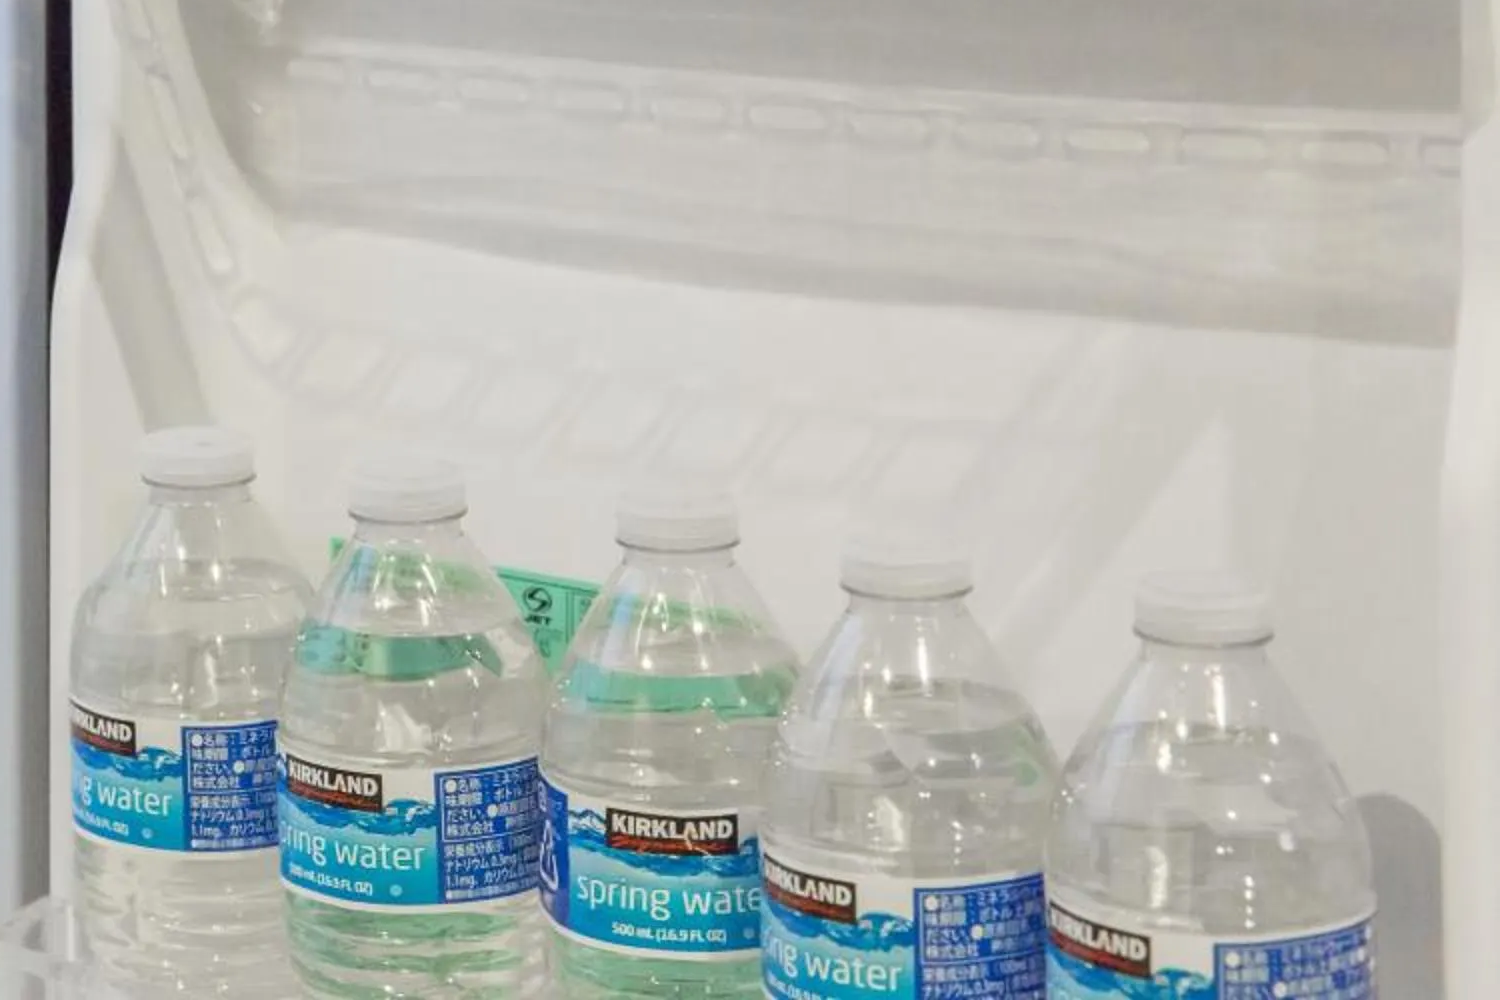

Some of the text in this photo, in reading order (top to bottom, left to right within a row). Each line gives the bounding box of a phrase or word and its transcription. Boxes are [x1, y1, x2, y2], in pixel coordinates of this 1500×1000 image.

[289, 759, 378, 797] KIRKLAND
[97, 781, 173, 817] water
[611, 813, 734, 840] KIRKLAND
[334, 840, 426, 870] water
[577, 875, 672, 922] spring
[681, 886, 762, 915] wate
[804, 951, 902, 991] water
